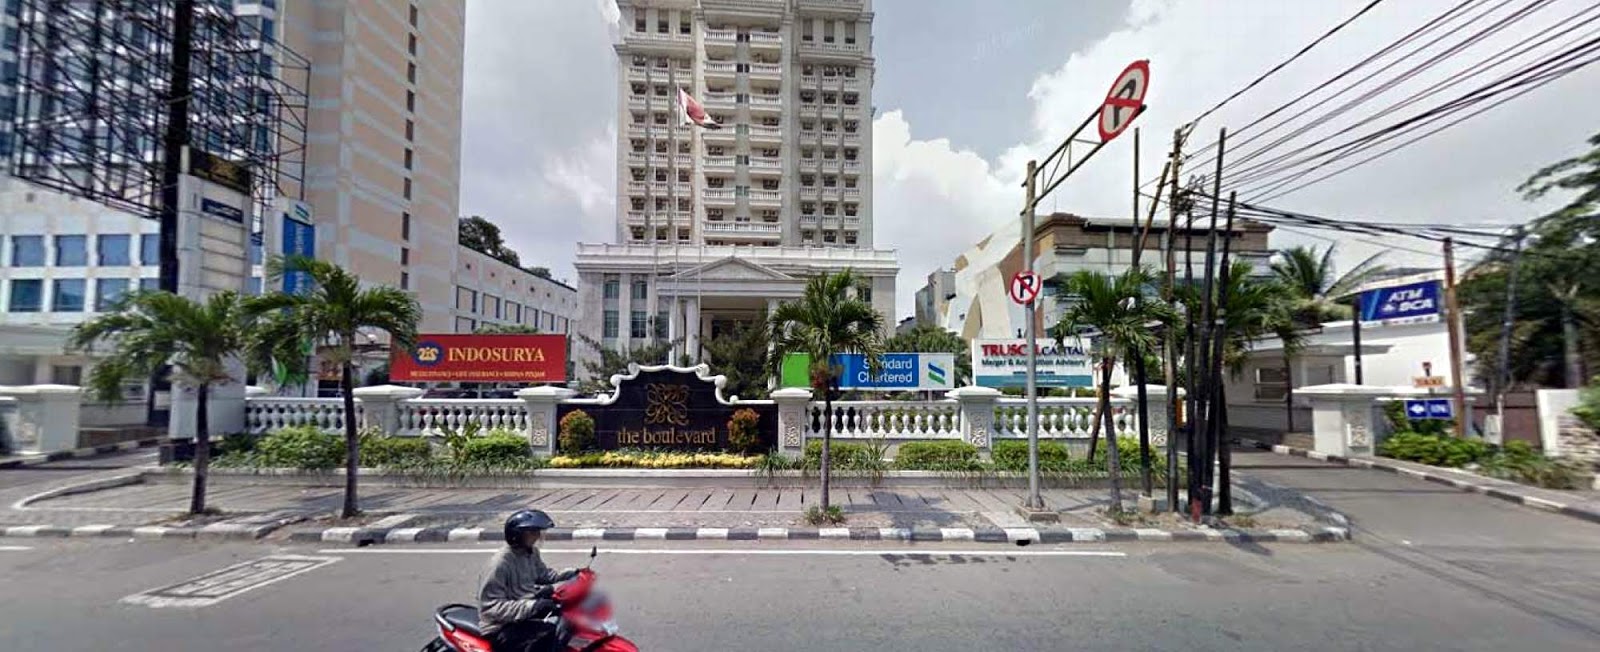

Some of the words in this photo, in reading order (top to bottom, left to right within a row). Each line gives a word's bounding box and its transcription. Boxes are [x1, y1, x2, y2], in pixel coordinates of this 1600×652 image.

[1388, 288, 1424, 302] ATM
[448, 347, 545, 362] INDOSURYA
[1041, 346, 1085, 356] CAITAL
[862, 358, 913, 370] Sndard
[617, 427, 640, 444] the
[642, 427, 716, 444] boulevard
